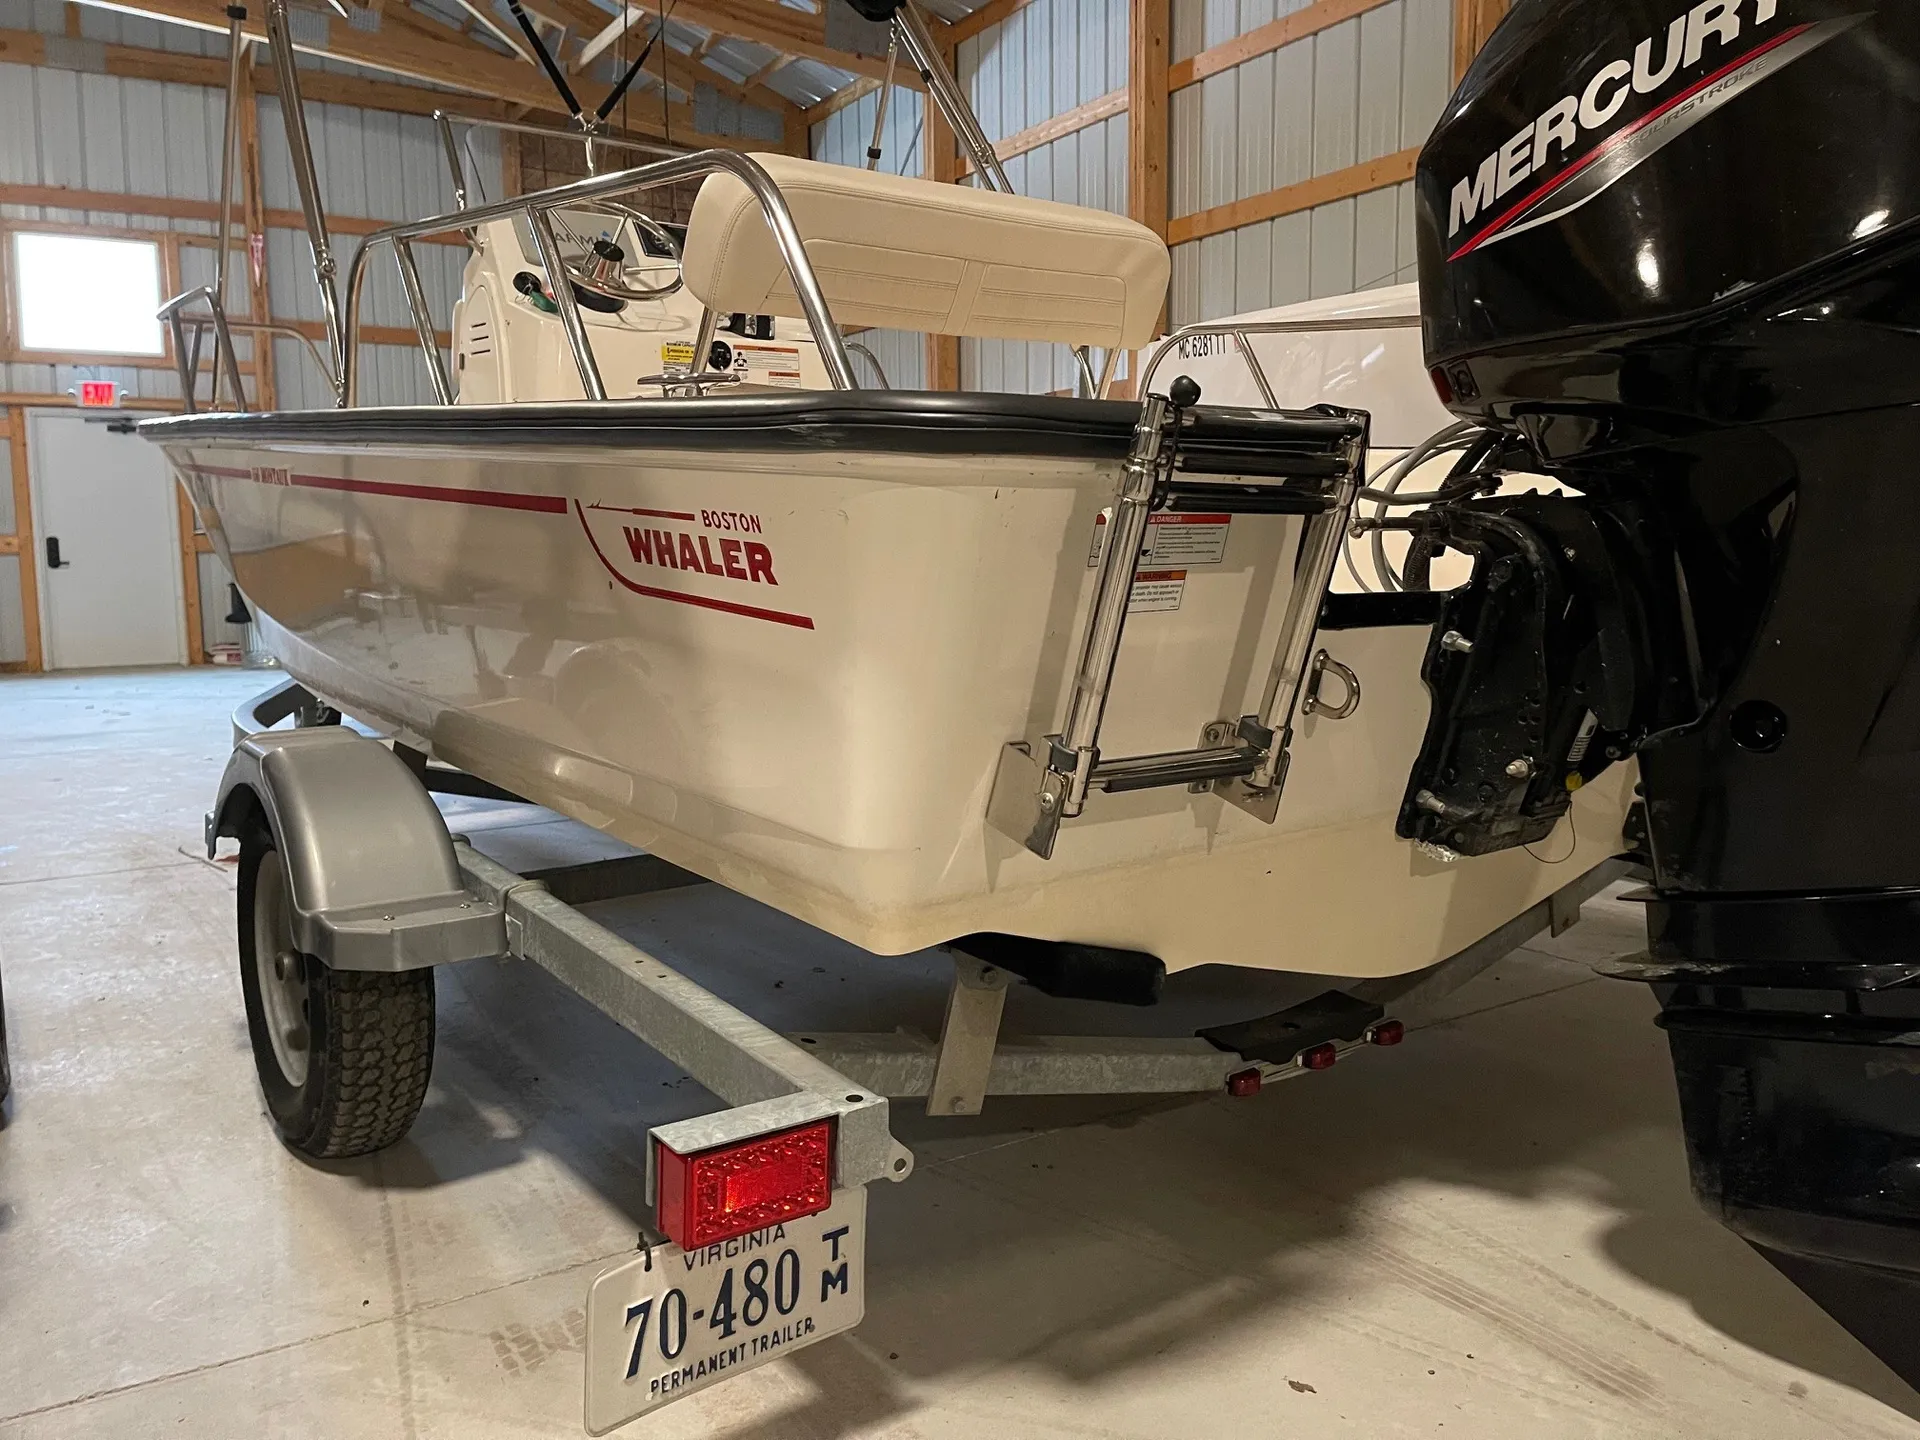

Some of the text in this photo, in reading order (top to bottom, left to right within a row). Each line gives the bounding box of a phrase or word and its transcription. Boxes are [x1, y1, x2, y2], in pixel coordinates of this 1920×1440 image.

[1178, 338, 1191, 360] MC
[701, 509, 762, 534] BOSTON
[1156, 515, 1182, 523] DANGER
[622, 526, 779, 586] WHALER
[683, 1224, 786, 1271] VIRGINIA
[624, 1248, 801, 1380] 70-480
[649, 1315, 815, 1394] PERMANENT TRAILER
